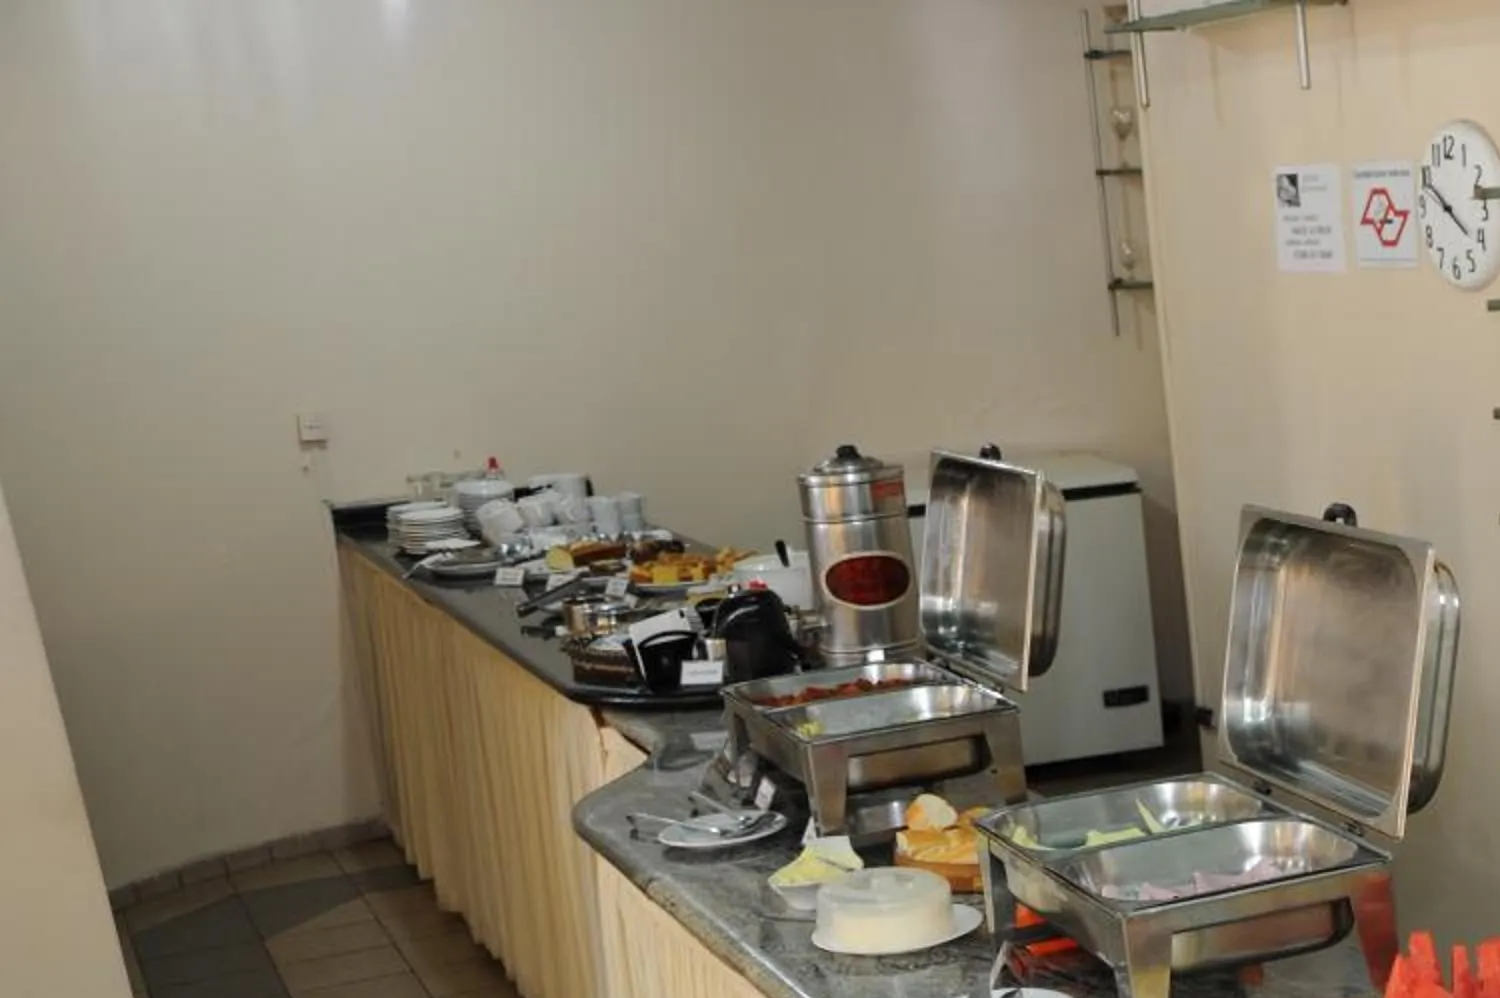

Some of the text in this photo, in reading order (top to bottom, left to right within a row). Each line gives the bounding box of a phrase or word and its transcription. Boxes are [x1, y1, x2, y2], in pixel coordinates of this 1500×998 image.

[1431, 143, 1441, 167] 11
[1443, 135, 1455, 160] 12
[1461, 143, 1467, 167] 1
[1421, 165, 1432, 189] 10
[1474, 164, 1483, 186] 2
[1418, 194, 1427, 219] 9
[1480, 197, 1489, 221] 3
[1425, 225, 1434, 248] 8
[1476, 227, 1487, 252] 4
[1436, 247, 1445, 270] 7
[1452, 255, 1461, 280] 6
[1466, 249, 1476, 272] 5
